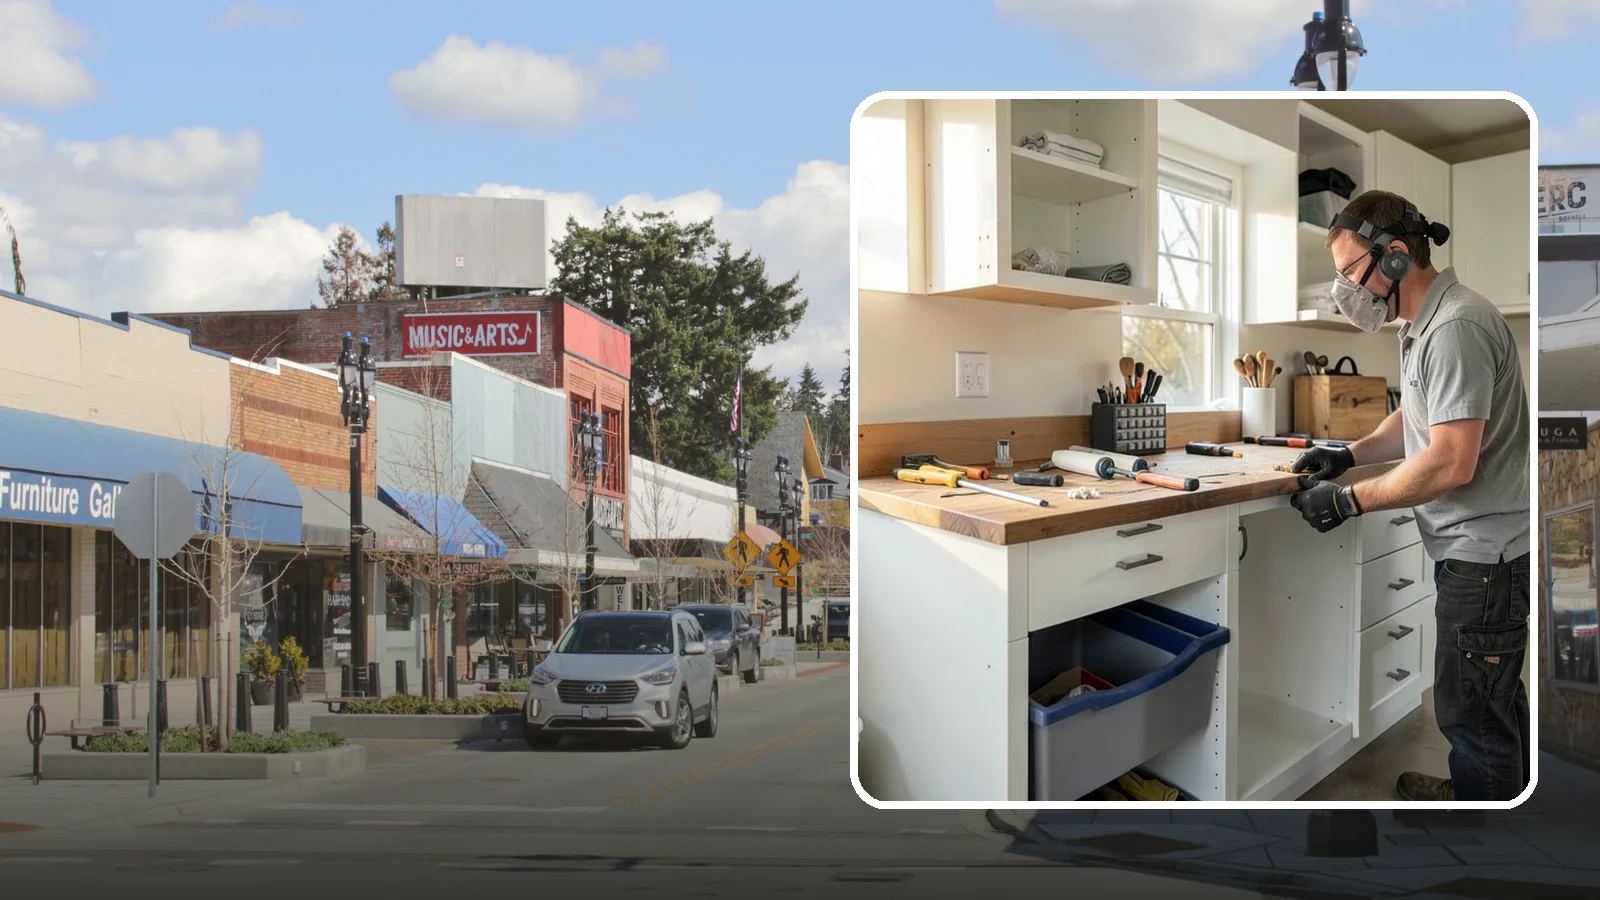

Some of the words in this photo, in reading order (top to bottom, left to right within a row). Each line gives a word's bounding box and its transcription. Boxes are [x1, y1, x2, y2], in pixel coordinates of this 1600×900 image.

[409, 322, 519, 349] MUSIC&ARTS
[0, 471, 79, 515] Furniture
[89, 482, 122, 519] Gal
